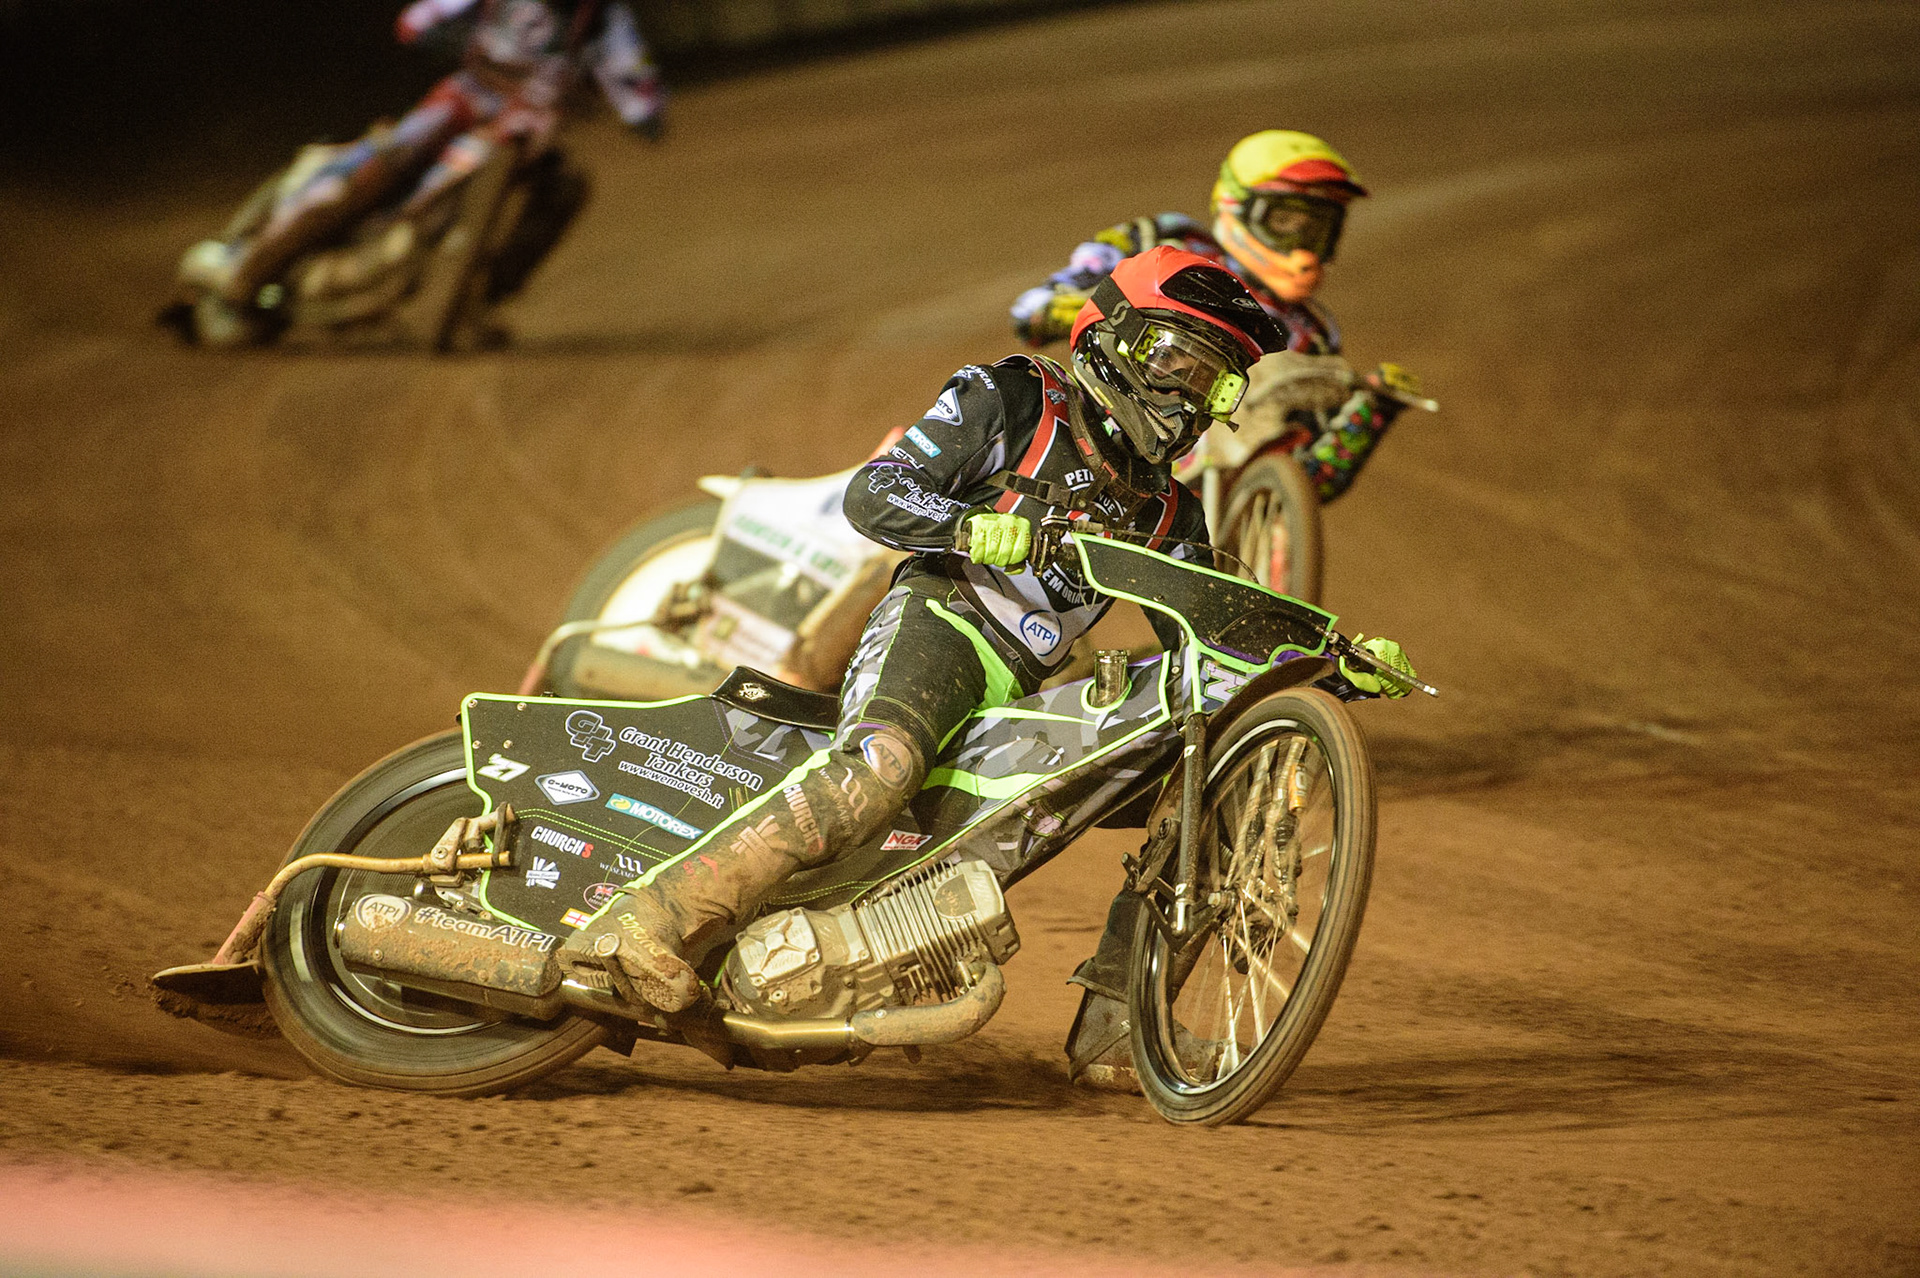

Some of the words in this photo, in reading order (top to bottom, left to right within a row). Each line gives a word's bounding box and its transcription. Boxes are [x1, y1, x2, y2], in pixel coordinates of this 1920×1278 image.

[1042, 568, 1087, 605] EMORIAL
[1026, 621, 1056, 646] ATPI
[619, 726, 671, 753] Grant
[667, 741, 763, 791] Henderson
[644, 752, 714, 788] Tankers
[870, 742, 906, 779] ATPI
[618, 761, 725, 809] www.wemovesh.it
[629, 802, 700, 839] MOTOREX
[887, 832, 928, 846] NGK
[366, 902, 399, 918] ATPI
[414, 907, 556, 952] #teamATPI
